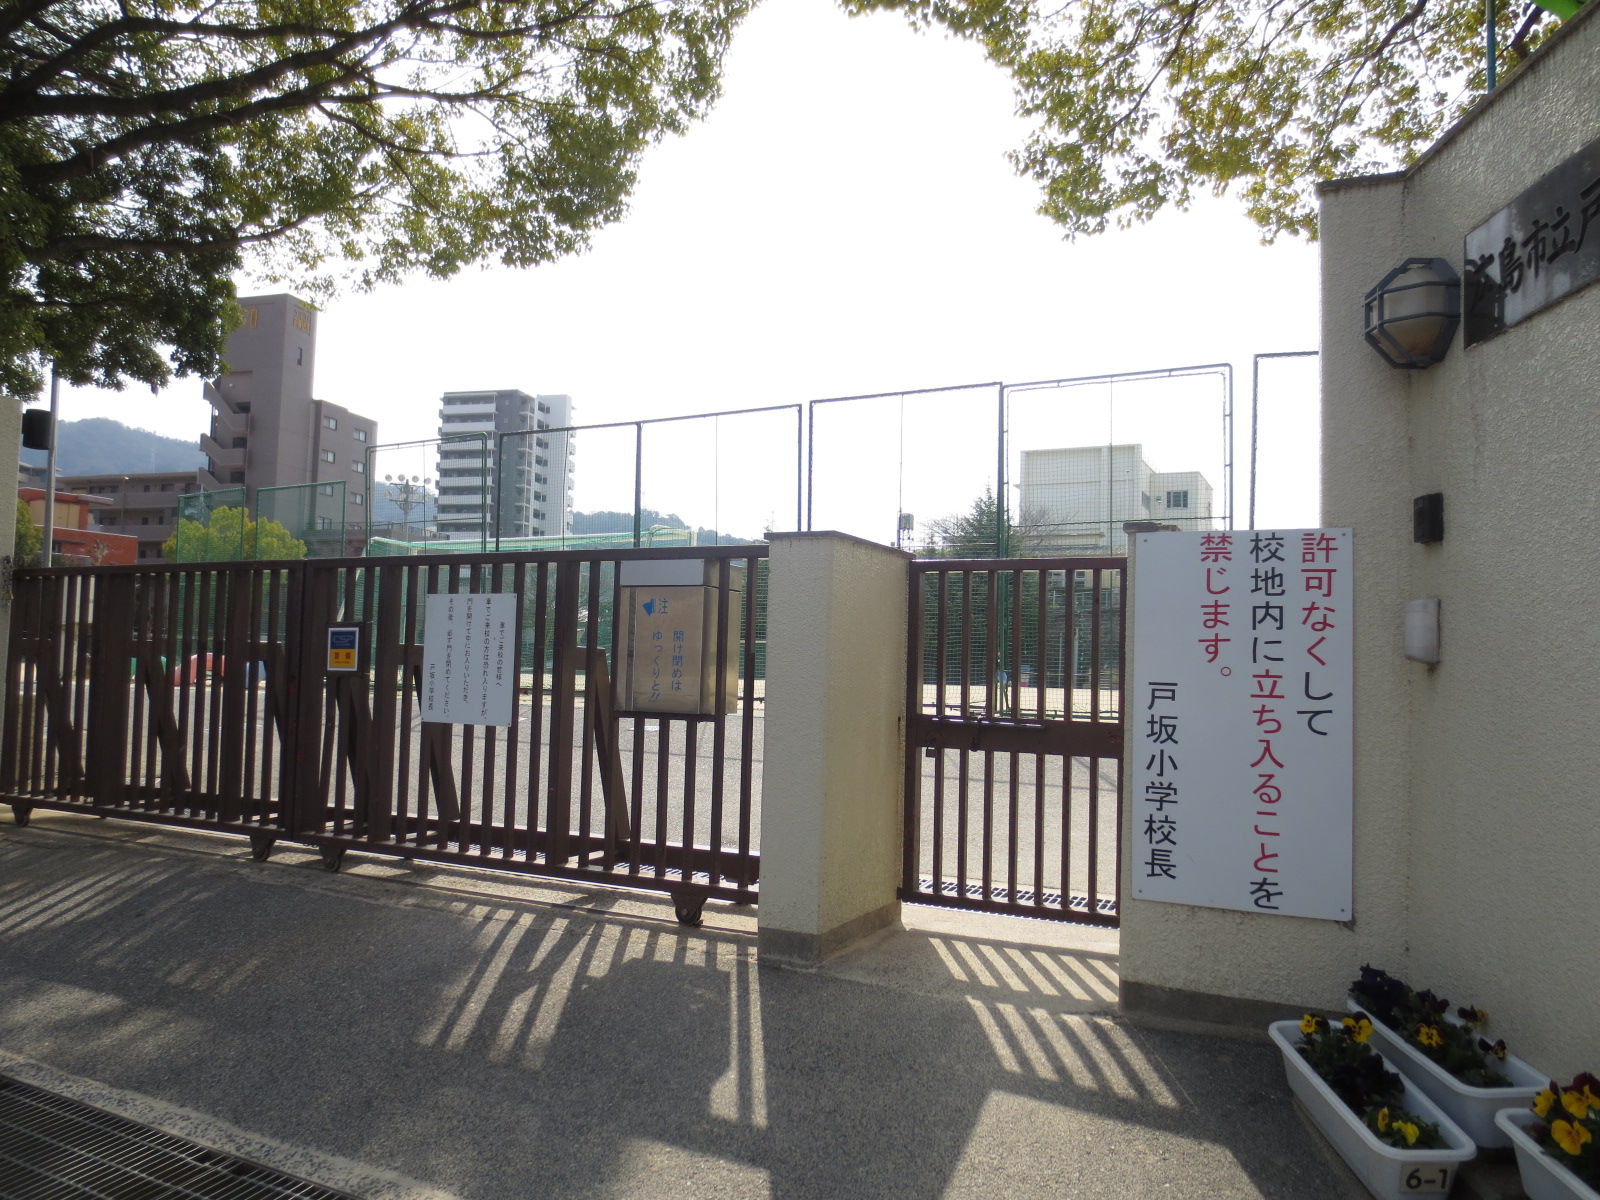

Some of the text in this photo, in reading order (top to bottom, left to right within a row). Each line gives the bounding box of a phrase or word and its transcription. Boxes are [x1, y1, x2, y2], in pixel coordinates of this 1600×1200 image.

[658, 597, 669, 615] 注
[671, 630, 685, 691] 開け閉めは
[1198, 532, 1234, 678] 禁じます。
[1296, 532, 1339, 737] 許可なくして
[1143, 681, 1180, 880] 戸坂小学校長
[1248, 532, 1286, 911] 校地内に立ち入ることを
[1405, 1167, 1448, 1190] 6-1
